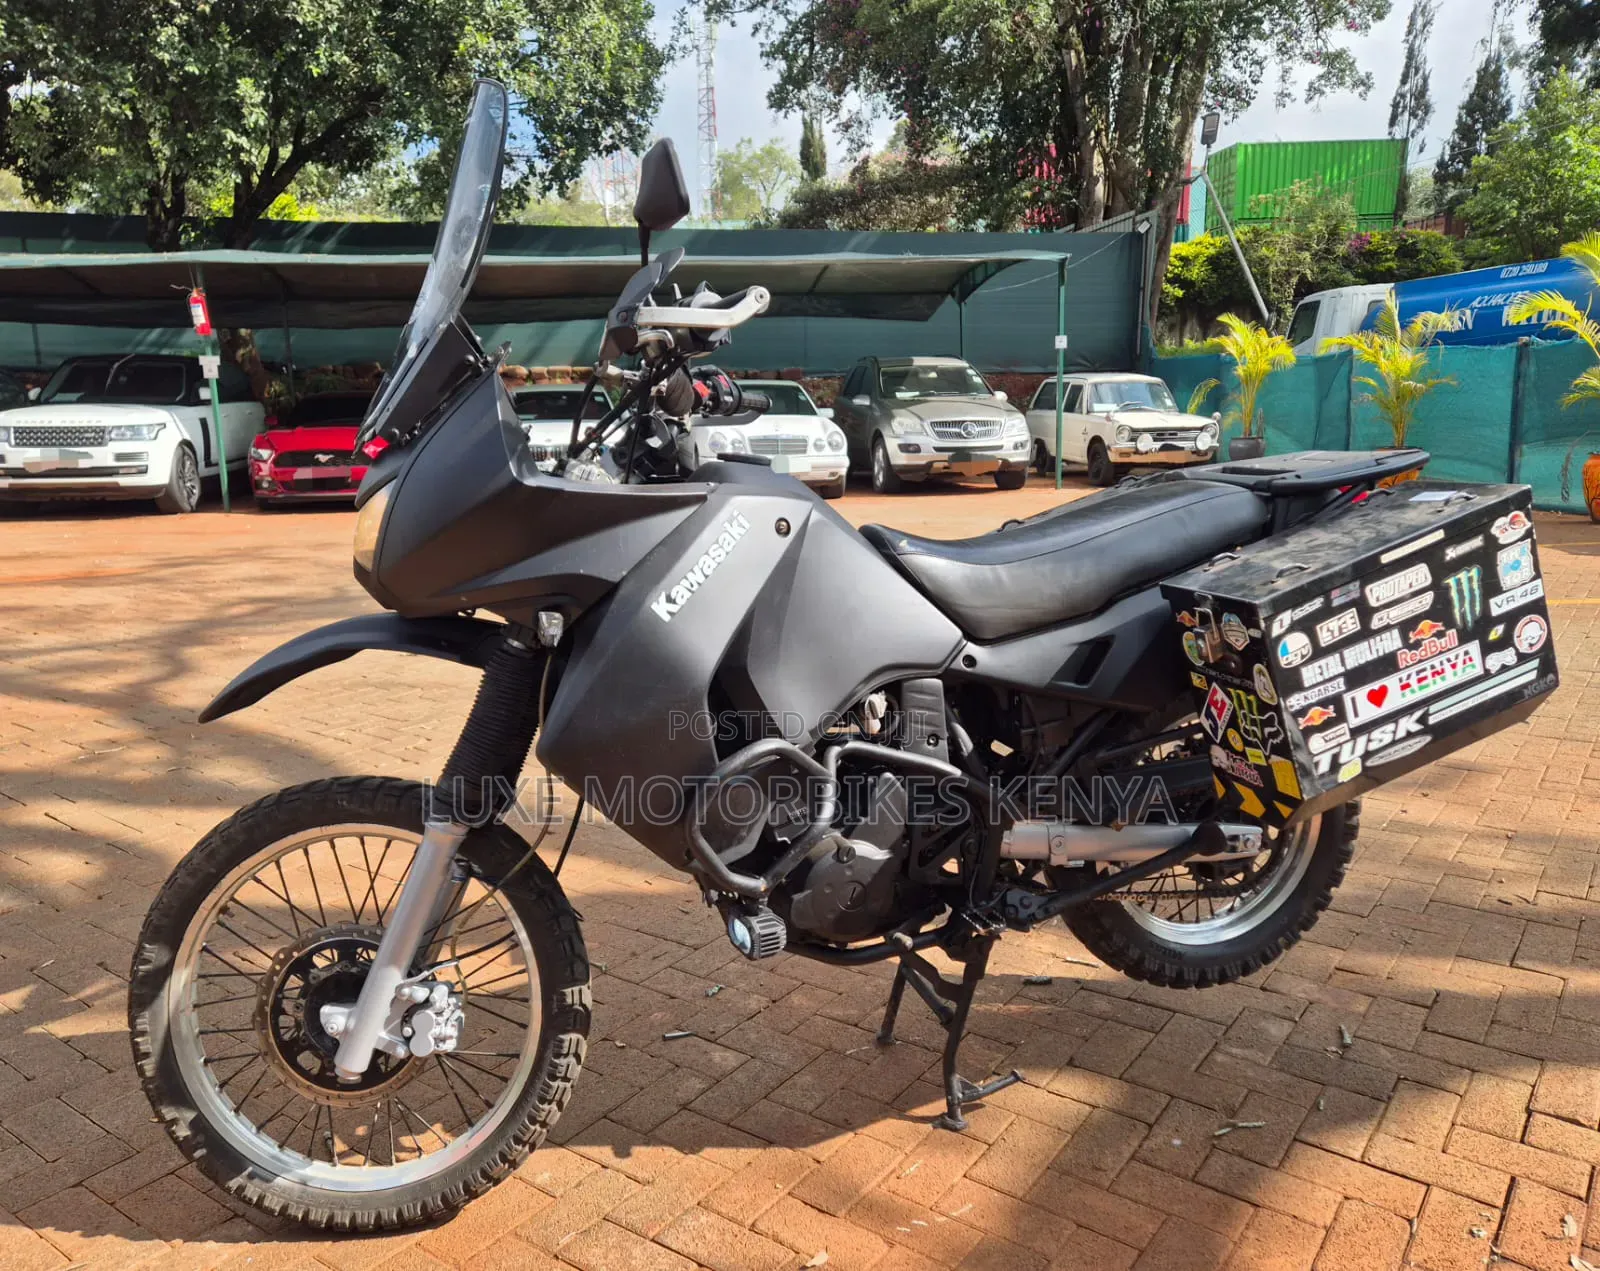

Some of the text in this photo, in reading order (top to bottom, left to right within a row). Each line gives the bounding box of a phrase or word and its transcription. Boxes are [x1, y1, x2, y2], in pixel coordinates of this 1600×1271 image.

[650, 510, 751, 623] Kawasaki
[1350, 696, 1360, 718] I
[1399, 649, 1477, 698] KENYA
[1313, 707, 1430, 776] TUSK
